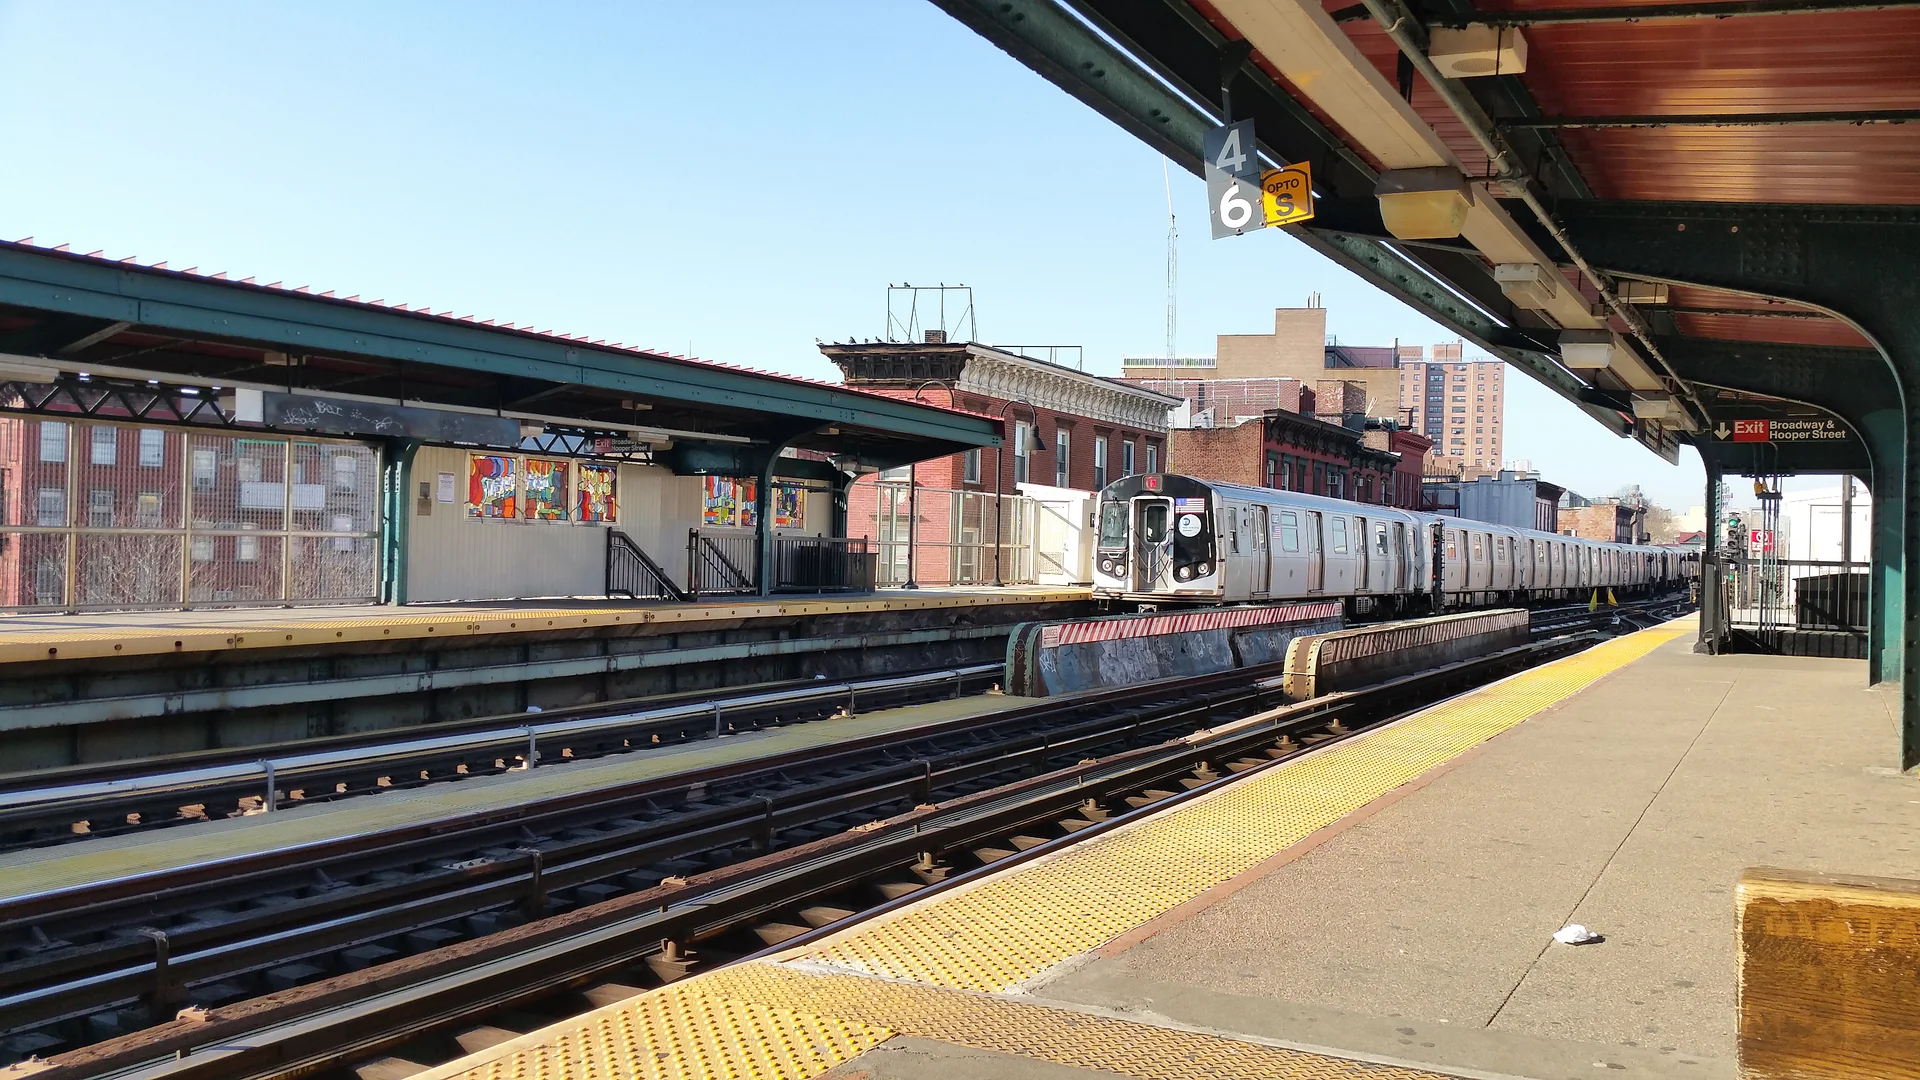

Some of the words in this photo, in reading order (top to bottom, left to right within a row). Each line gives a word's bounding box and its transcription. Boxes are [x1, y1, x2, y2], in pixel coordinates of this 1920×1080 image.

[1216, 129, 1247, 172] 4
[1267, 178, 1299, 194] OPTO
[1220, 185, 1252, 228] 6
[1276, 193, 1294, 216] S
[1735, 421, 1764, 434] Exit
[1770, 421, 1825, 431] Broadway
[1826, 420, 1835, 429] &
[1770, 431, 1811, 441] Hooper
[1812, 430, 1846, 439] Street
[596, 439, 610, 448] Exit
